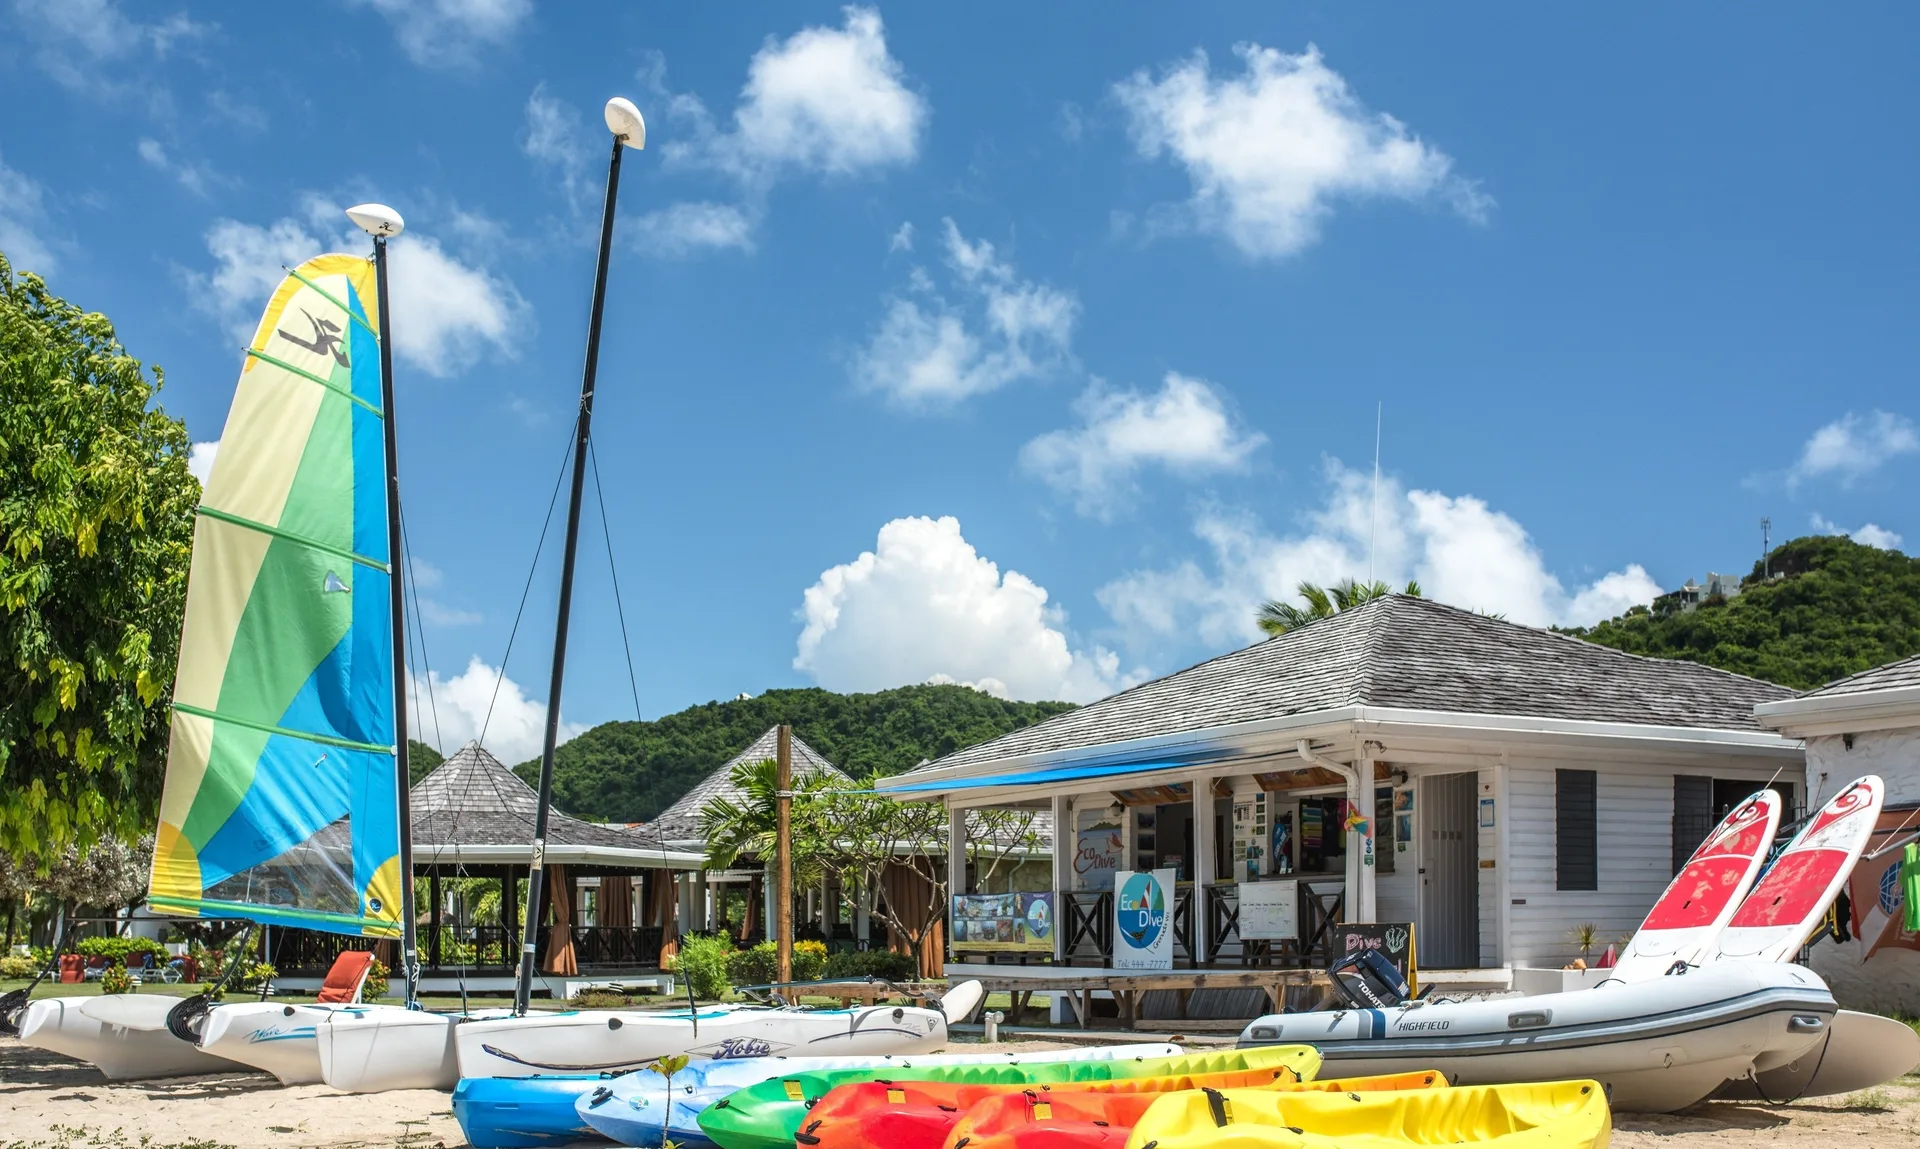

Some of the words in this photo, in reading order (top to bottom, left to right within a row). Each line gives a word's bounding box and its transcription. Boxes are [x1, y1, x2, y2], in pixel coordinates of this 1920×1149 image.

[1073, 837, 1095, 874] Eco
[1094, 854, 1116, 869] Dive
[1121, 894, 1138, 911] Eco
[1346, 933, 1382, 951] Dive
[243, 1024, 281, 1041] Wave
[1398, 1021, 1450, 1031] HIGHFIELD
[712, 1038, 771, 1059] Hobie
